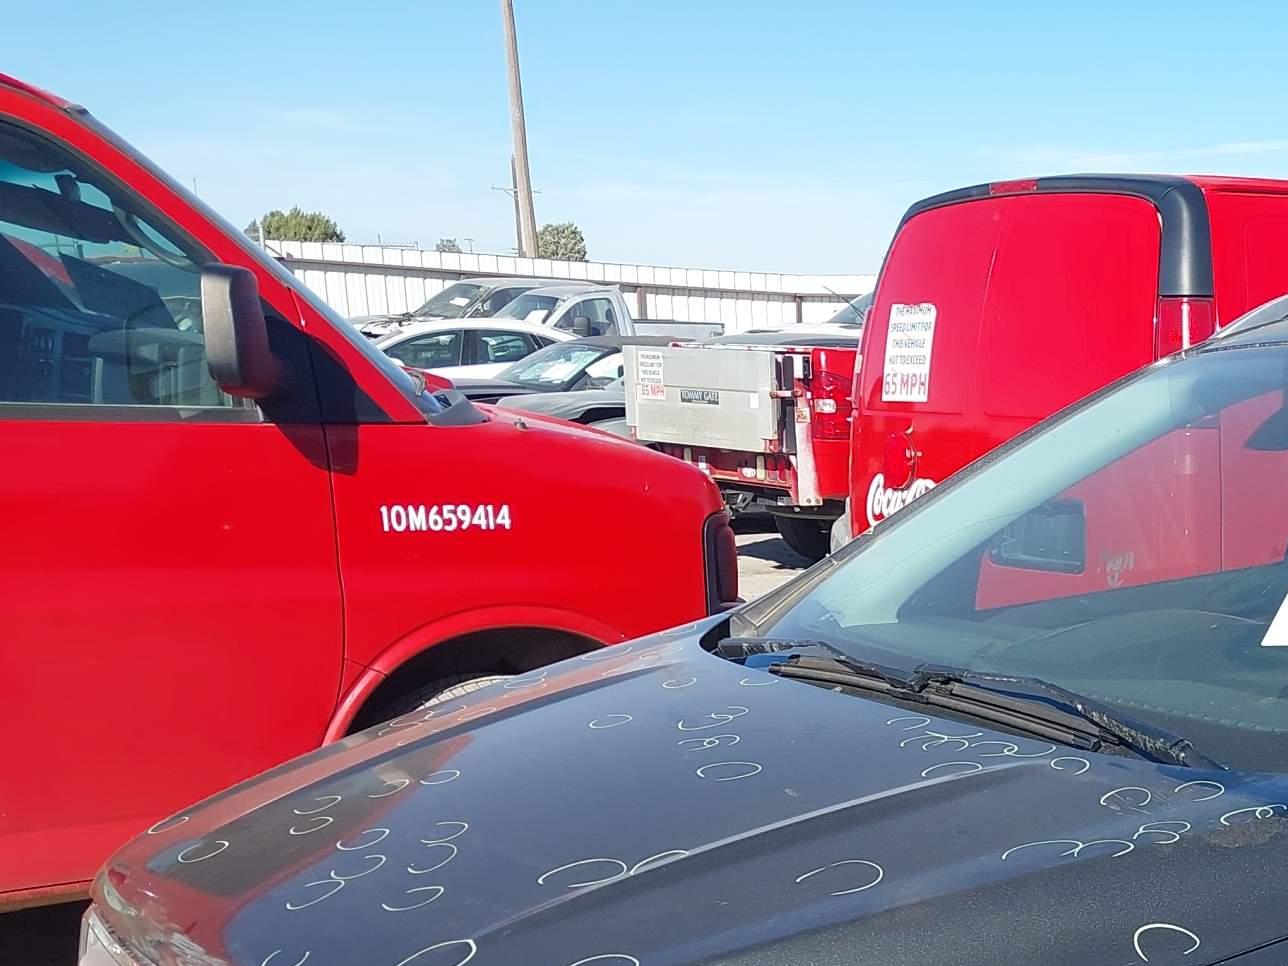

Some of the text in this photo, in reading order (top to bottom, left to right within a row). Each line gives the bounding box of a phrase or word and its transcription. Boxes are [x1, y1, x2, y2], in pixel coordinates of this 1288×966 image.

[891, 323, 905, 333] SPEED
[906, 322, 920, 332] LIMIT
[893, 339, 926, 348] THIS VEHICLE
[907, 355, 926, 364] EXCEED
[884, 373, 927, 395] 65 MPH
[650, 384, 664, 397] MPH
[681, 390, 702, 401] TOMMY
[380, 504, 512, 532] 10M659414
